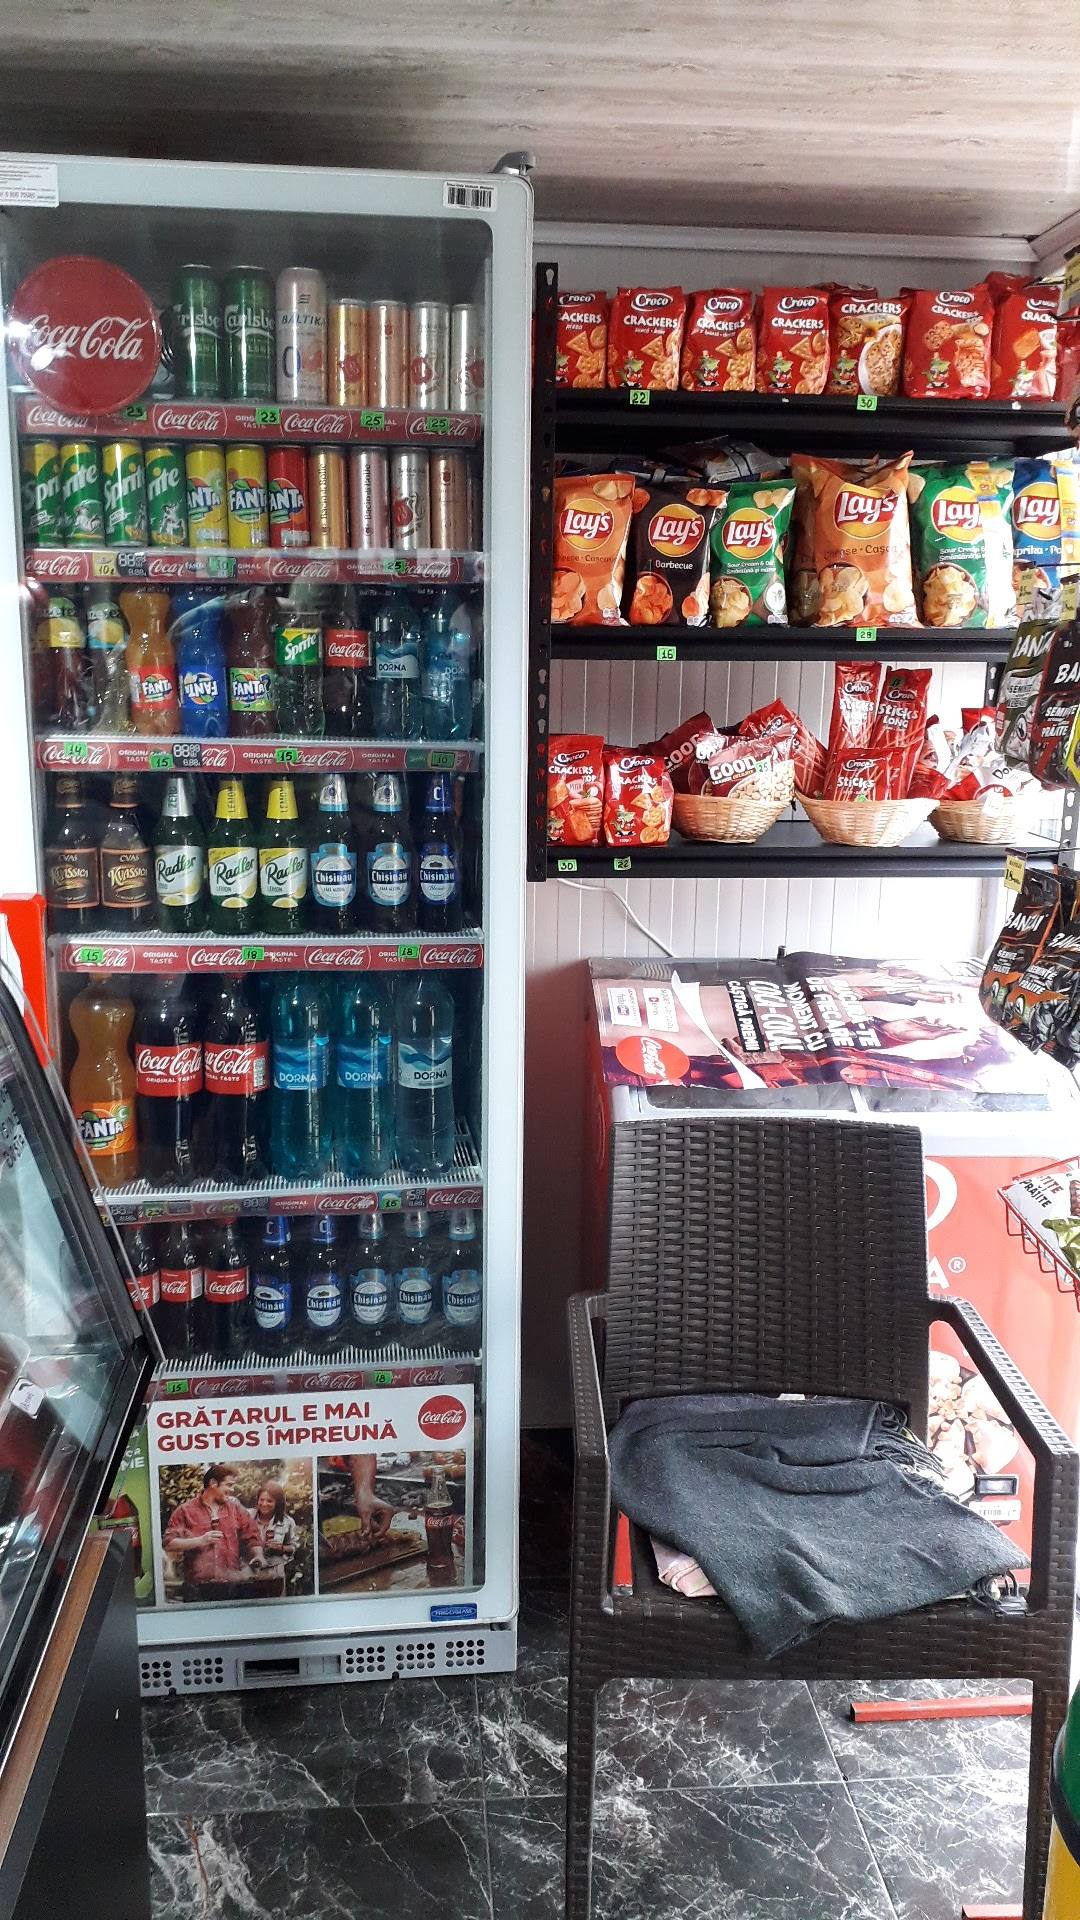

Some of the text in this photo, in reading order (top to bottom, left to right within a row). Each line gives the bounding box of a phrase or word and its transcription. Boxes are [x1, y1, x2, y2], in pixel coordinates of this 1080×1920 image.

[635, 293, 669, 306] Croco
[708, 297, 738, 310] Croco
[781, 296, 816, 308] Croco
[939, 291, 971, 304] Croco
[841, 303, 902, 315] CRACKERS
[623, 314, 679, 328] CRACKERS
[696, 317, 746, 331] CRACKERS
[771, 317, 824, 329] CRACKERS
[633, 392, 648, 403] 22
[859, 398, 873, 408] 30
[157, 408, 223, 431] Coca-Cola
[260, 412, 279, 424] 23
[284, 412, 348, 435] Coca-Cola
[364, 413, 383, 427] 25
[430, 418, 447, 430] 25
[270, 488, 304, 512] ANTA
[838, 490, 898, 526] Lay's
[564, 508, 611, 540] Lay's
[653, 516, 701, 546] Lay's
[727, 517, 775, 548] Lay's
[271, 559, 337, 578] Coca-Cola
[387, 562, 403, 571] 25
[655, 558, 694, 571] Barbecue
[284, 632, 317, 661] Sprite
[328, 641, 366, 659] Coca-Cola
[661, 649, 674, 660] 16
[378, 662, 407, 673] DORNA
[141, 678, 174, 697] FANTA
[184, 679, 219, 697] FANTA
[232, 679, 265, 696] FANTA
[878, 703, 919, 720] Sticks
[882, 715, 909, 729] LONG
[156, 757, 169, 767] 15
[280, 750, 293, 761] 15
[361, 752, 396, 760] ORIGINAL
[548, 765, 594, 775] CRACKERS
[709, 755, 757, 782] GOOD
[581, 774, 597, 783] TOP
[837, 776, 876, 789] Sticks
[157, 849, 198, 883] Radler
[215, 857, 256, 885] Radler
[266, 856, 305, 886] Radler
[617, 859, 629, 869] 22
[85, 951, 100, 962] 15
[191, 948, 247, 967] Coca-Cola
[247, 950, 258, 960] 18
[308, 948, 366, 966] Coca-Cola
[401, 947, 414, 957] 18
[423, 947, 477, 965] Coca-Cola
[749, 980, 805, 1052] COCA-COLA!
[805, 976, 855, 1047] DE FIECARE
[739, 1017, 761, 1051] PREMII
[804, 1031, 828, 1052] CU
[137, 1048, 202, 1076] Coca-Cola
[145, 1076, 177, 1084] ORIGINAL
[279, 1072, 318, 1084] DORNA
[345, 1071, 384, 1082] DORNA
[413, 1070, 448, 1081] DORNA
[77, 1116, 124, 1139] FANTA
[429, 1188, 480, 1206] Coca-Cola
[209, 1279, 246, 1296] Coca-Cola
[375, 1373, 386, 1383] 18
[172, 1383, 183, 1393] 15
[156, 1401, 370, 1430] GRĂTARUL E MAI
[420, 1409, 465, 1425] Coca-Cola
[156, 1419, 397, 1452] GUSTOS ÎMPREUNĂ
